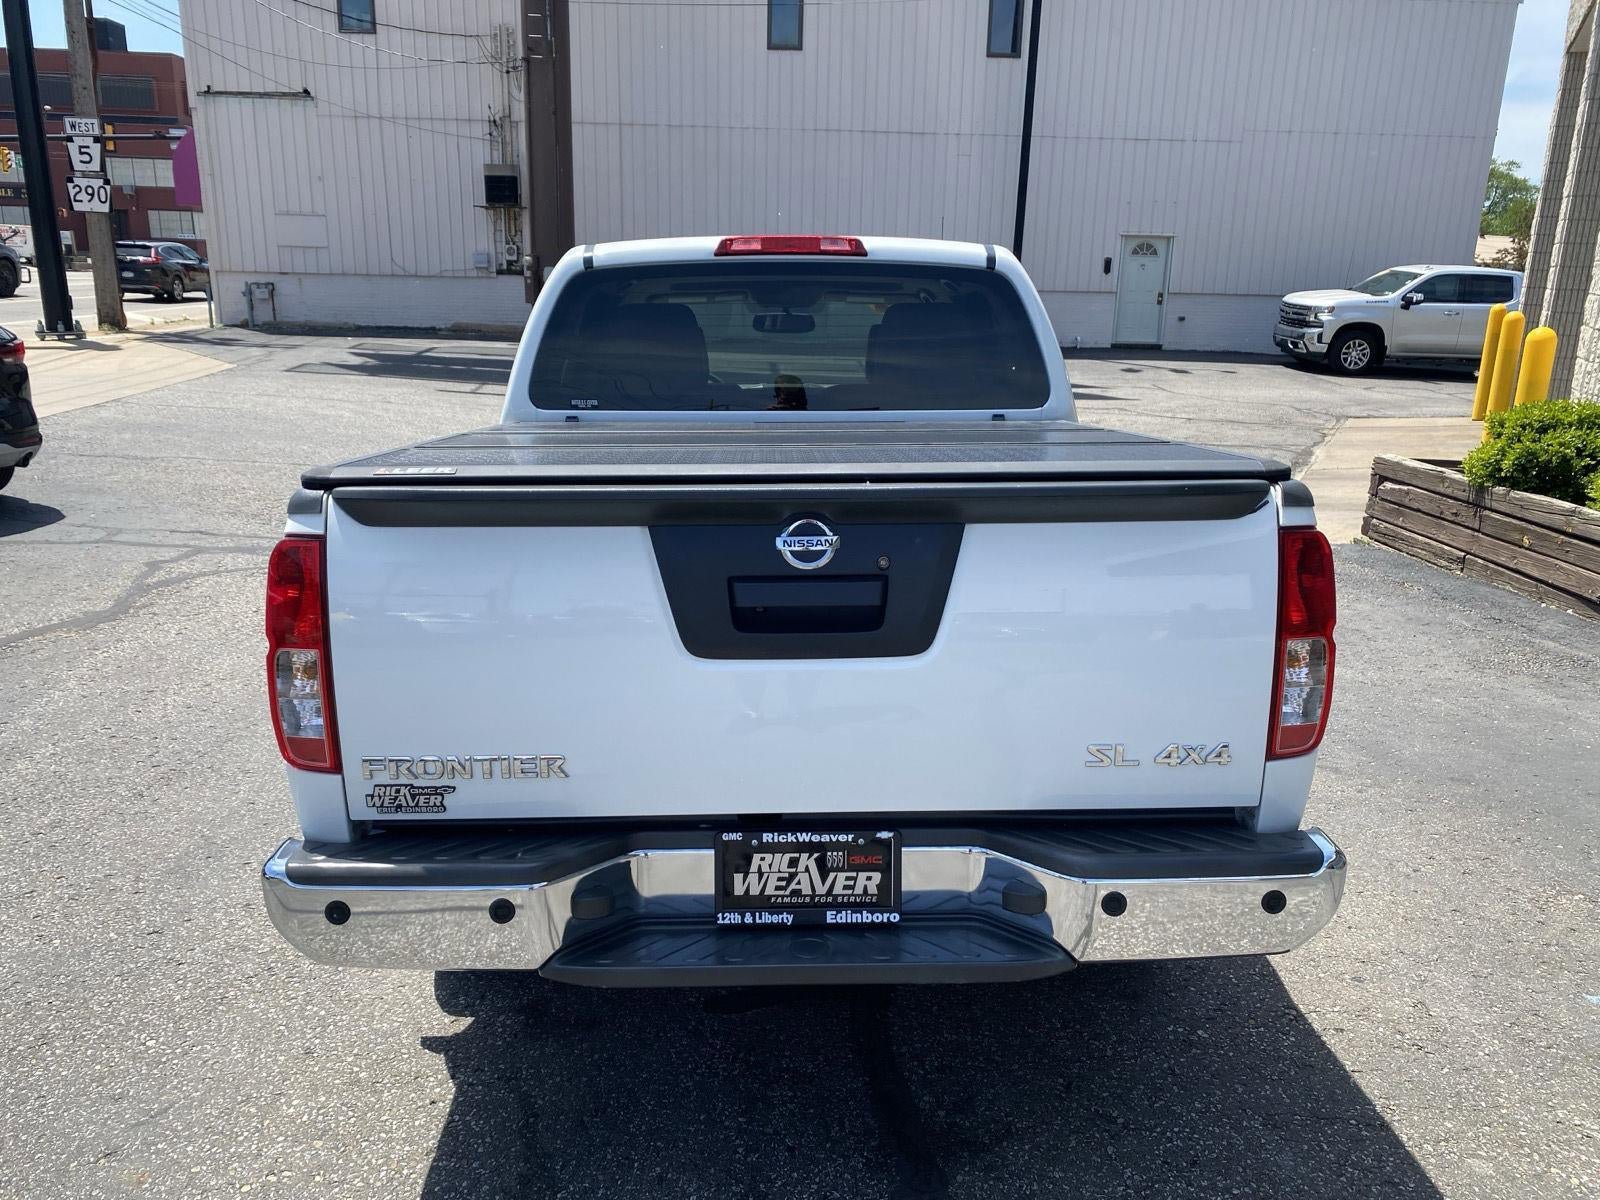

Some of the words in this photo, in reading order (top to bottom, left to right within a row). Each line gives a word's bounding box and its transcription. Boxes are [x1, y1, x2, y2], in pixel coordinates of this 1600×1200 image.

[68, 120, 96, 133] WEST
[78, 145, 93, 165] 5
[72, 184, 108, 204] 290
[782, 538, 834, 548] NISSAN
[1085, 743, 1140, 767] SL
[361, 754, 570, 780] FRONTIER
[373, 785, 411, 797] RICK
[366, 795, 443, 807] WEAVER
[722, 832, 743, 841] GMC
[762, 832, 854, 843] RickWeaver
[749, 853, 822, 873] RICK
[850, 855, 883, 864] GMC
[733, 871, 882, 896] WEAVER
[717, 912, 742, 924] 12th
[744, 912, 753, 923] &
[755, 911, 794, 925] Liberty
[826, 910, 900, 923] Edinboro
